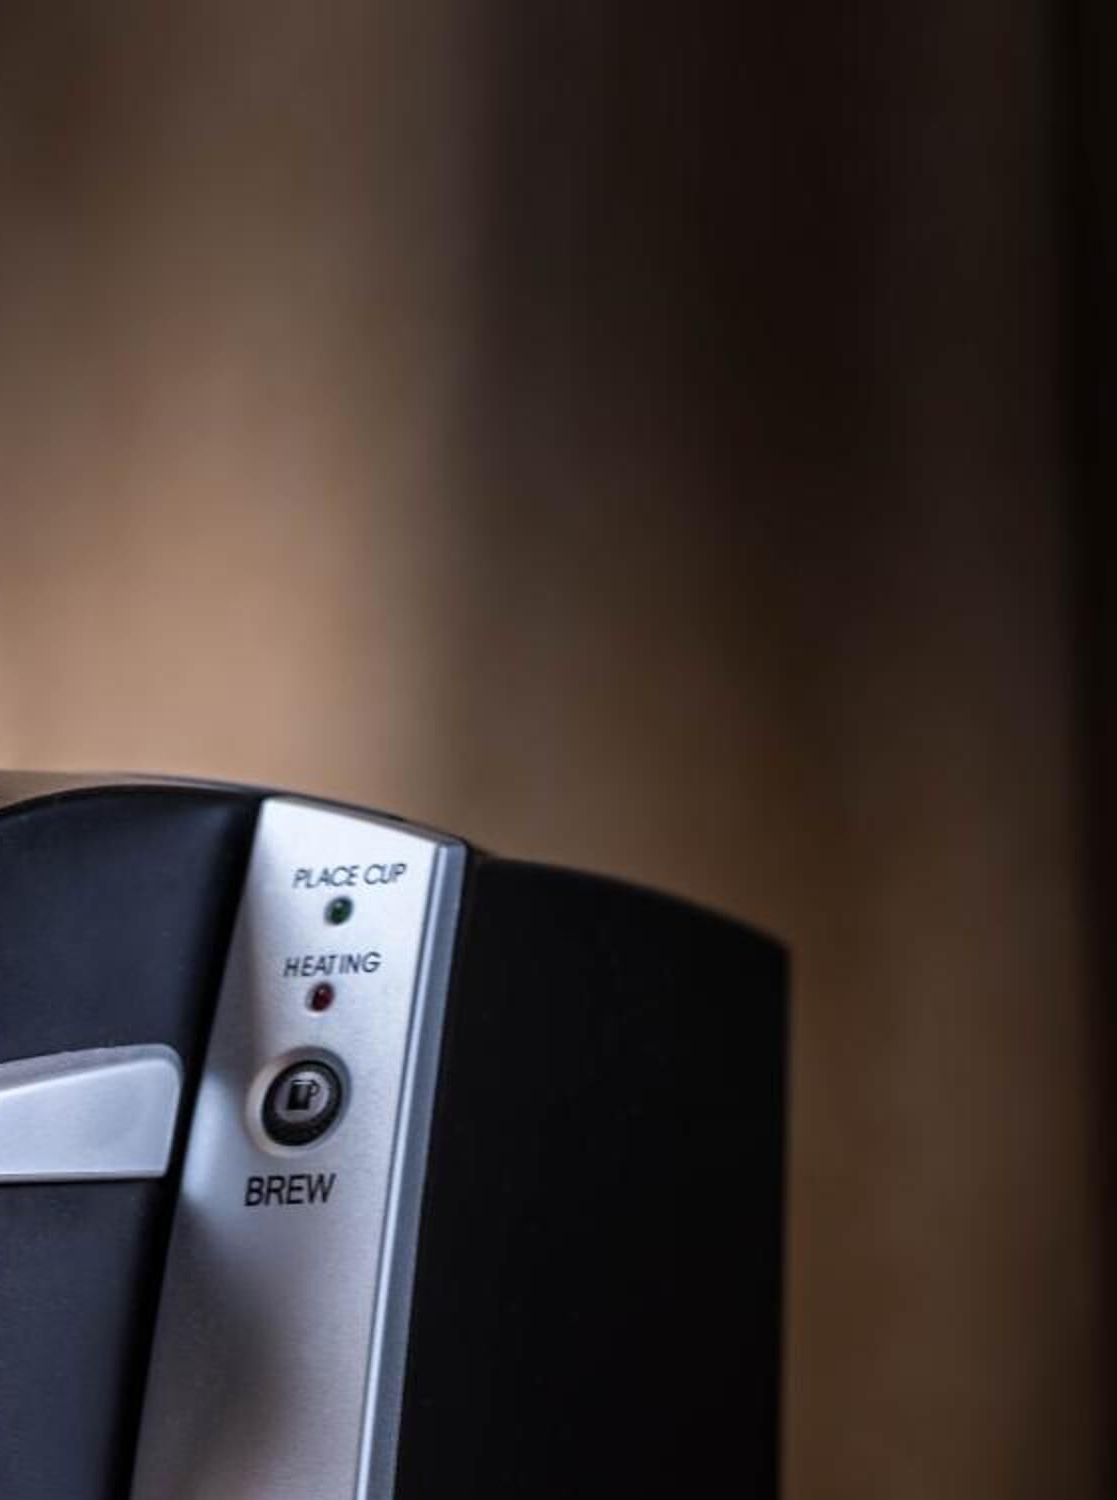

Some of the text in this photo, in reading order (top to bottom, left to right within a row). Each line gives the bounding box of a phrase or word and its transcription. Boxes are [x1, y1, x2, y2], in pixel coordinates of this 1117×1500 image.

[292, 863, 407, 888] PLACE CUP
[284, 952, 382, 977] HEATING
[244, 1174, 336, 1206] BREW
